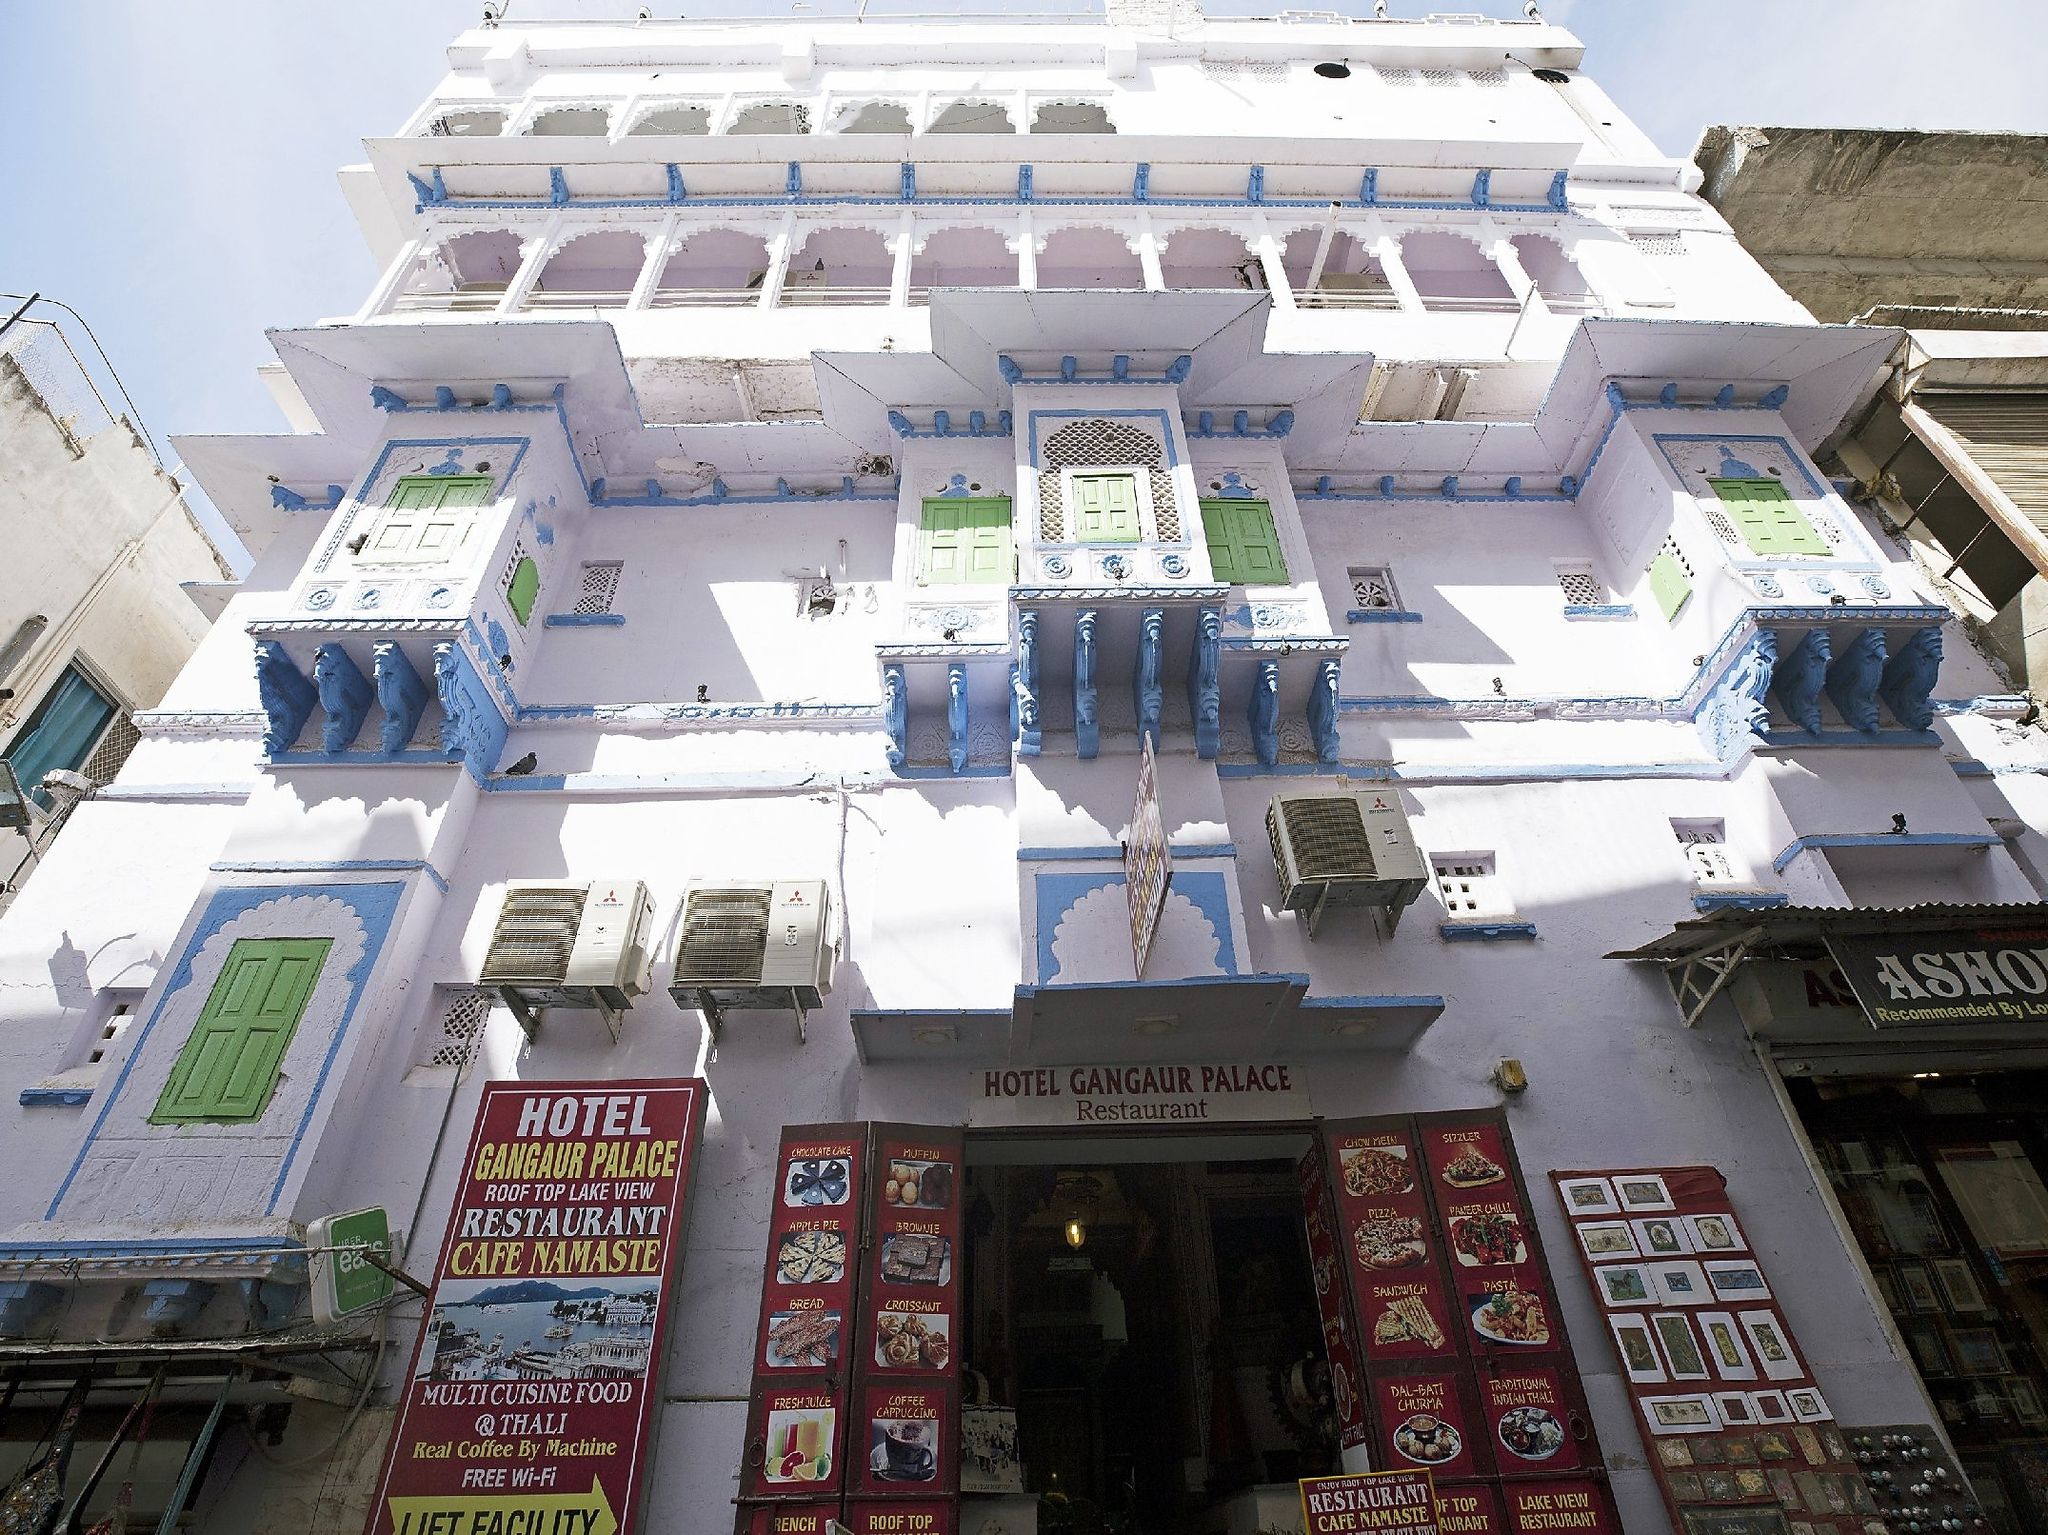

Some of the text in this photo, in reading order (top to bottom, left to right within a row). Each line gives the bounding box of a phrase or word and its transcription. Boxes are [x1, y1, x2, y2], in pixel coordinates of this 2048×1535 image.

[1876, 948, 2048, 1000] ASHO
[1875, 1002, 1998, 1022] Recommended
[1998, 1001, 2024, 1019] By
[984, 1064, 1292, 1097] HOTEL GANGAUR PALACE
[516, 1095, 651, 1137] HOTEL
[1076, 1098, 1208, 1121] Restaurant
[1344, 1136, 1400, 1148] CHOW MEIN
[1442, 1132, 1482, 1144] SIZZLER
[791, 1146, 851, 1158] CHOCOLATE CAKE
[903, 1148, 940, 1160] MUFFIN
[474, 1140, 679, 1181] GANGAUR PALACE
[484, 1182, 656, 1202] ROOF TOP LAKE VIEW
[1368, 1207, 1398, 1218] PIZZA
[1449, 1202, 1513, 1215] PANEER CHILLI
[459, 1206, 667, 1239] RESTAURANT
[788, 1220, 840, 1232] APPLE PIE
[896, 1222, 940, 1234] BROWNIE
[451, 1239, 662, 1276] CAFE NAMASTE
[1372, 1283, 1428, 1297] SANDWICH
[1482, 1280, 1517, 1292] PASTA
[789, 1298, 824, 1310] BREAD
[885, 1300, 942, 1312] CROISSANT
[1390, 1382, 1444, 1398] DAL-BATI
[1489, 1376, 1551, 1392] TRADITIONAL
[420, 1381, 634, 1406] MULTI CUISINE FOOD
[888, 1395, 926, 1406] COFFEE
[1492, 1391, 1555, 1406] INDIAN THALI
[774, 1396, 832, 1410] FRESH JUICE
[1398, 1398, 1444, 1412] CHURMA
[876, 1408, 937, 1420] CAPPUCCINO
[474, 1412, 568, 1437] & THALI
[412, 1437, 618, 1462] Real Coffee By Machine
[461, 1466, 556, 1488] FREE Wi-Fi
[1316, 1474, 1415, 1490] ENJOY ROOF TOP LAKE VIEW
[1308, 1483, 1428, 1514] RESTAURANT
[1452, 1498, 1478, 1512] TOP
[1518, 1493, 1590, 1510] LAKE VIEW
[401, 1508, 601, 1535] LIFT FACILITY
[774, 1516, 817, 1532] RENCH
[869, 1515, 932, 1530] ROOF TOP
[1318, 1513, 1356, 1532] CAFE
[1360, 1506, 1429, 1528] NAMASTE
[1440, 1516, 1488, 1532] AURANT
[1519, 1512, 1598, 1530] RESTAURANT
